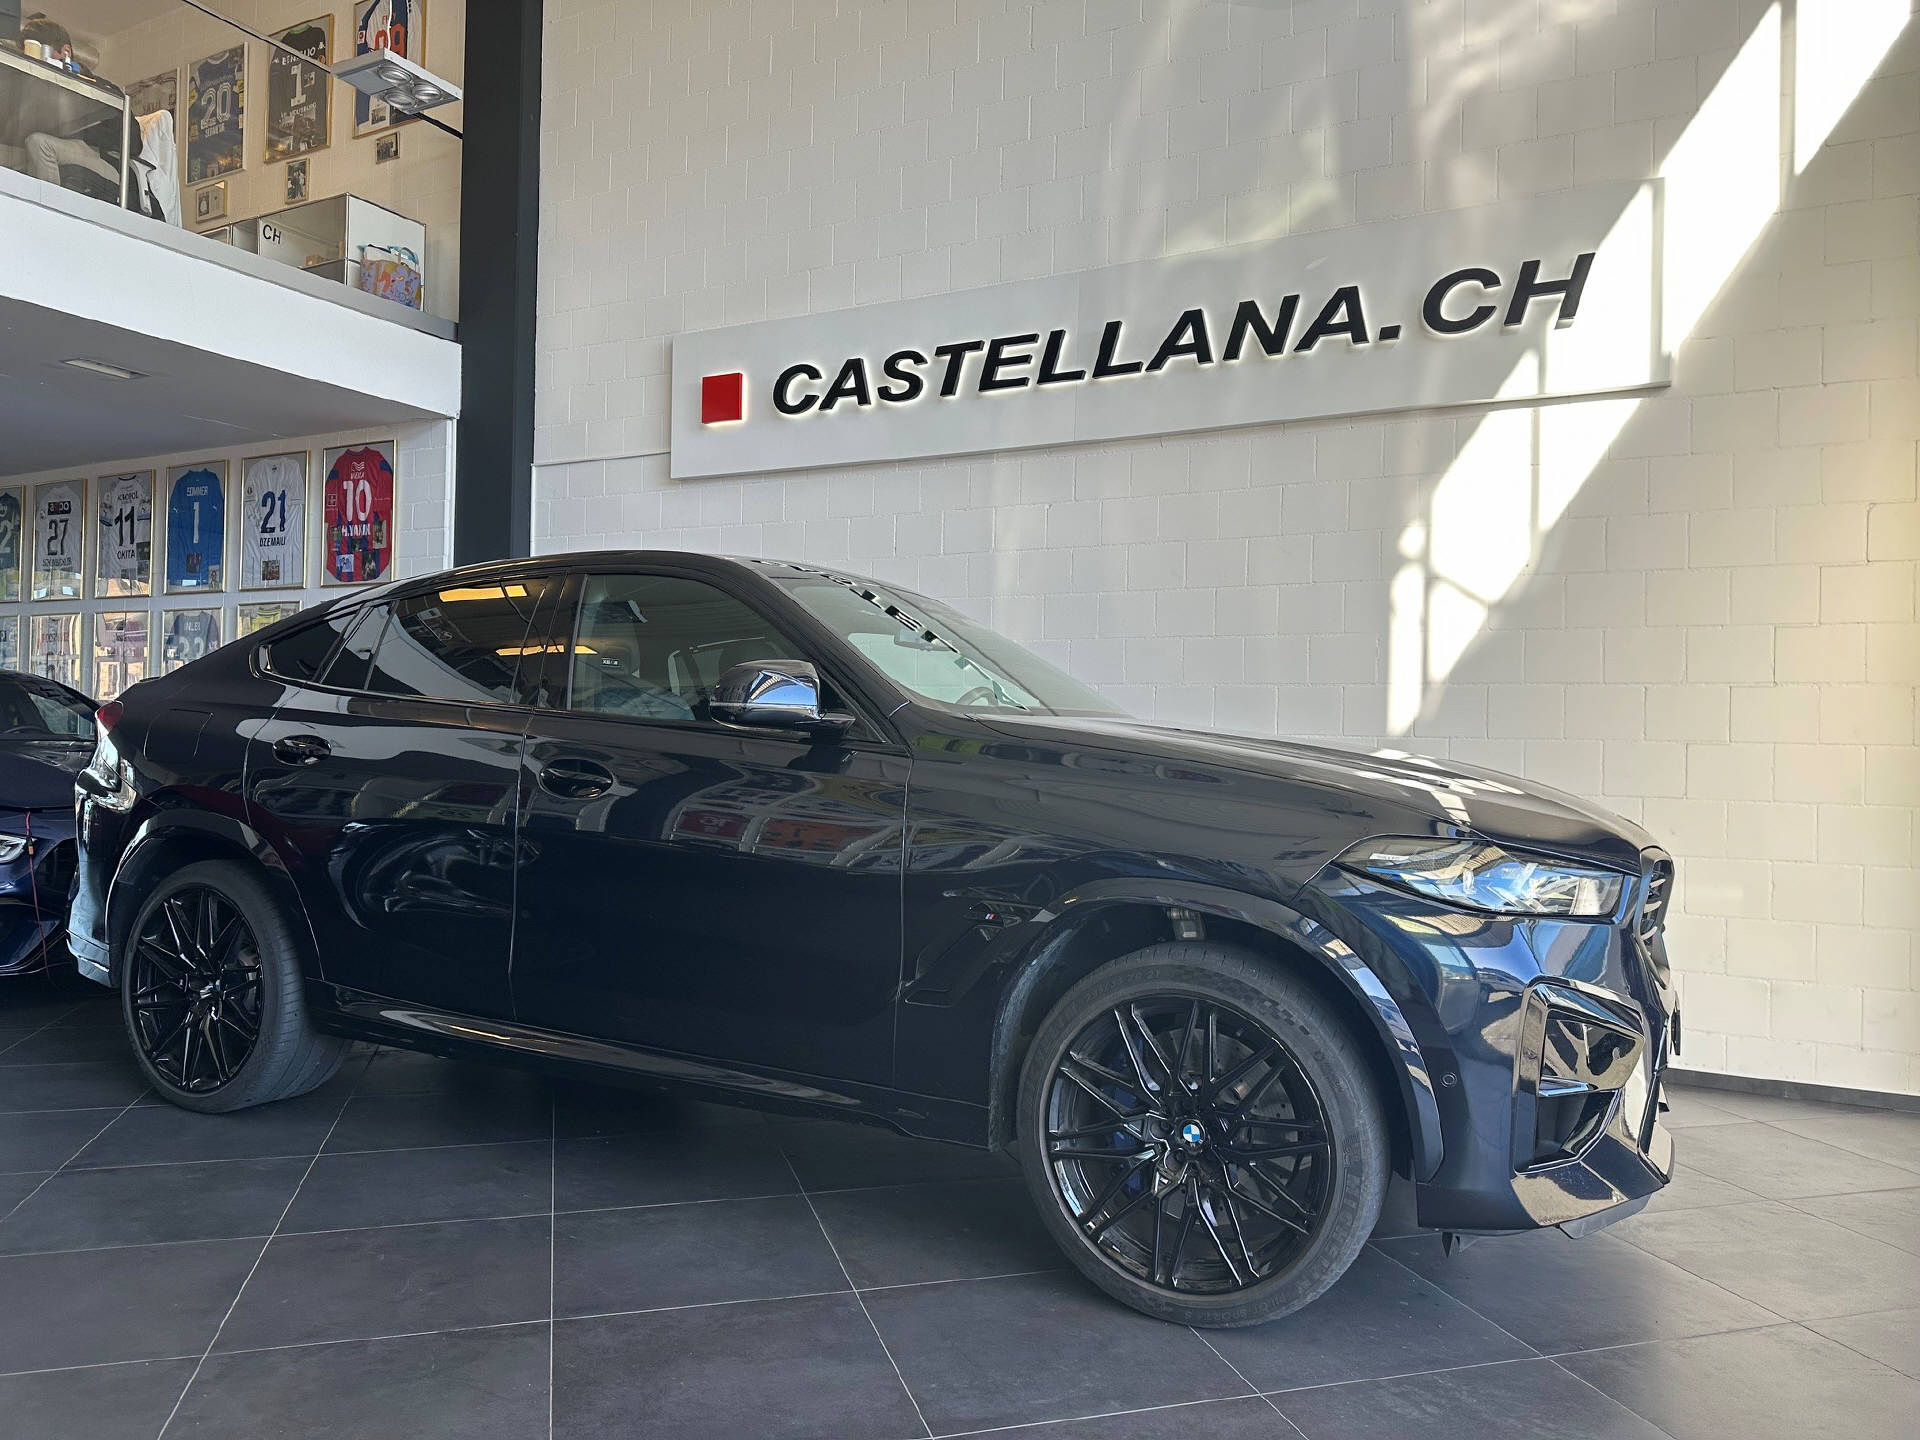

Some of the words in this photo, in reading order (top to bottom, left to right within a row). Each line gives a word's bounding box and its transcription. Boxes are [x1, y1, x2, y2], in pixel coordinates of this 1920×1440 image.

[201, 82, 232, 129] 20
[262, 224, 282, 245] CH
[772, 252, 1596, 417] CASTELLANA.CH
[260, 489, 287, 534] 21
[343, 480, 372, 522] 10
[47, 518, 69, 556] 27
[114, 506, 135, 547] 11
[193, 502, 200, 544] 1
